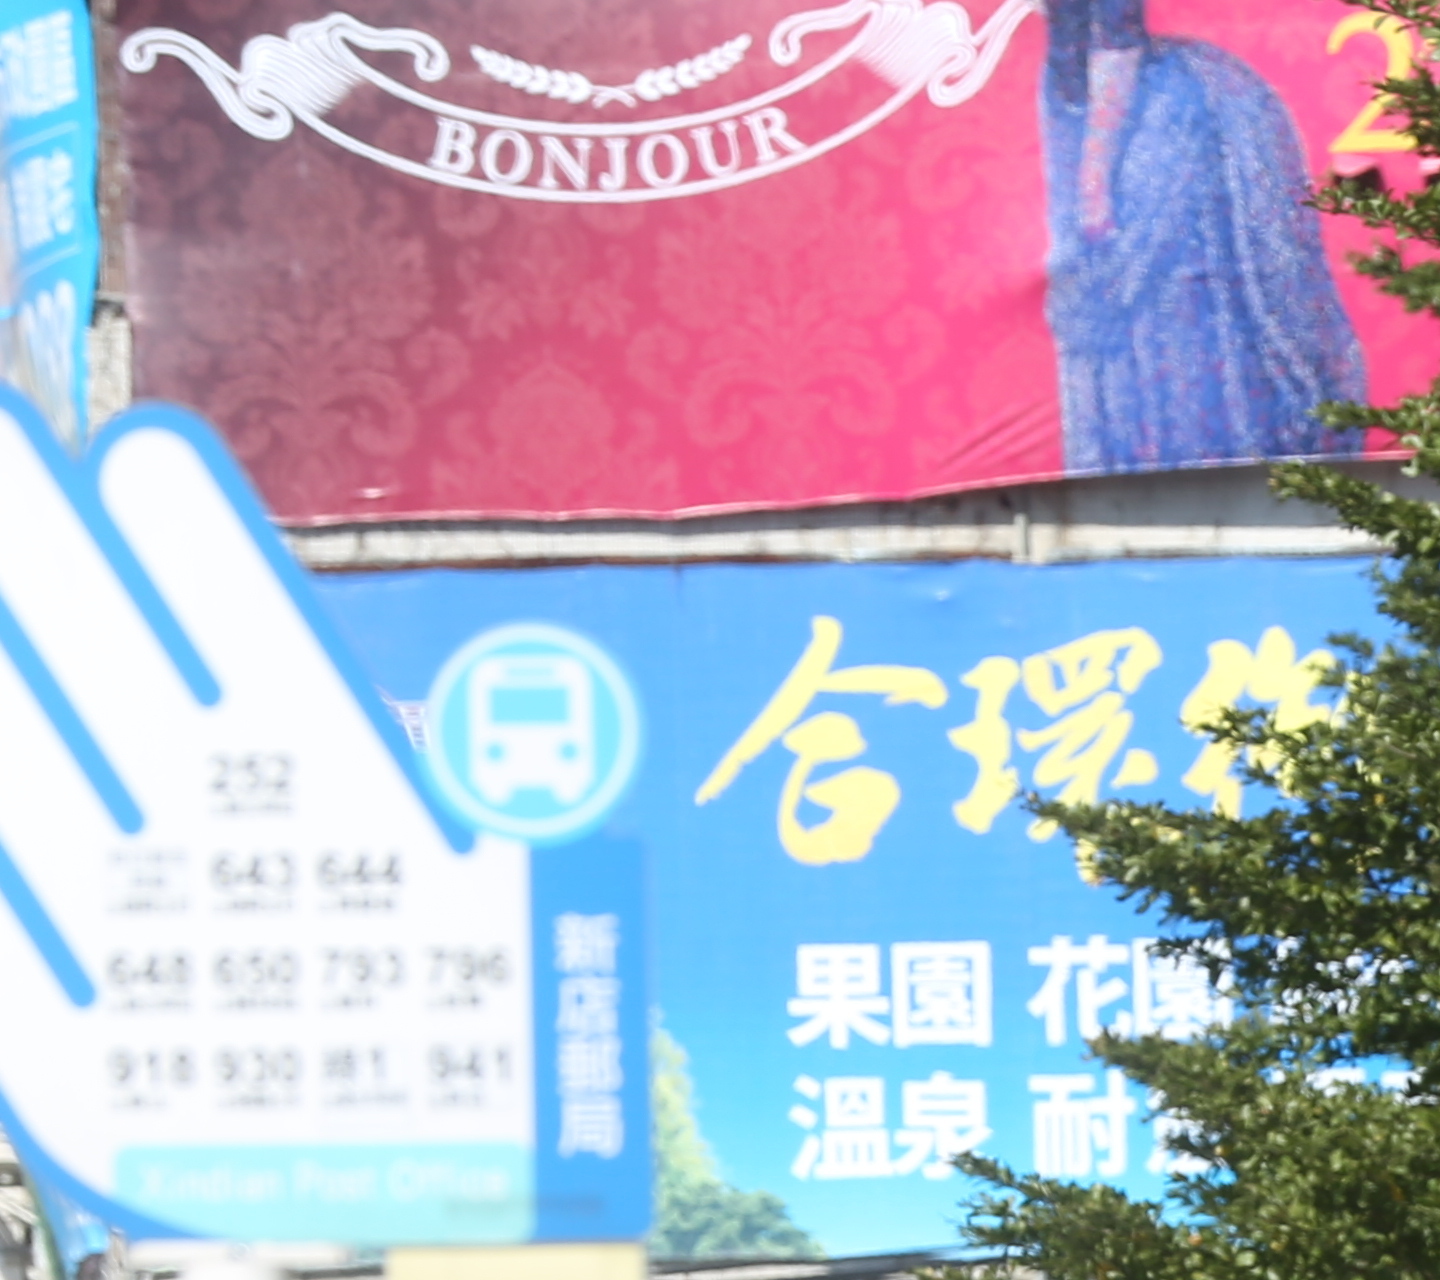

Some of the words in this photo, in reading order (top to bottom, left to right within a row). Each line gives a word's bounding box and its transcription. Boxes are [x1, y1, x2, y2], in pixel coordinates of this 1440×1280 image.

[427, 105, 810, 192] BONJOUR
[209, 754, 293, 794] 252
[318, 853, 402, 888] 644
[555, 911, 625, 1158] 新店郵局
[787, 940, 993, 1048] 果園
[787, 1072, 993, 1182] 溫泉
